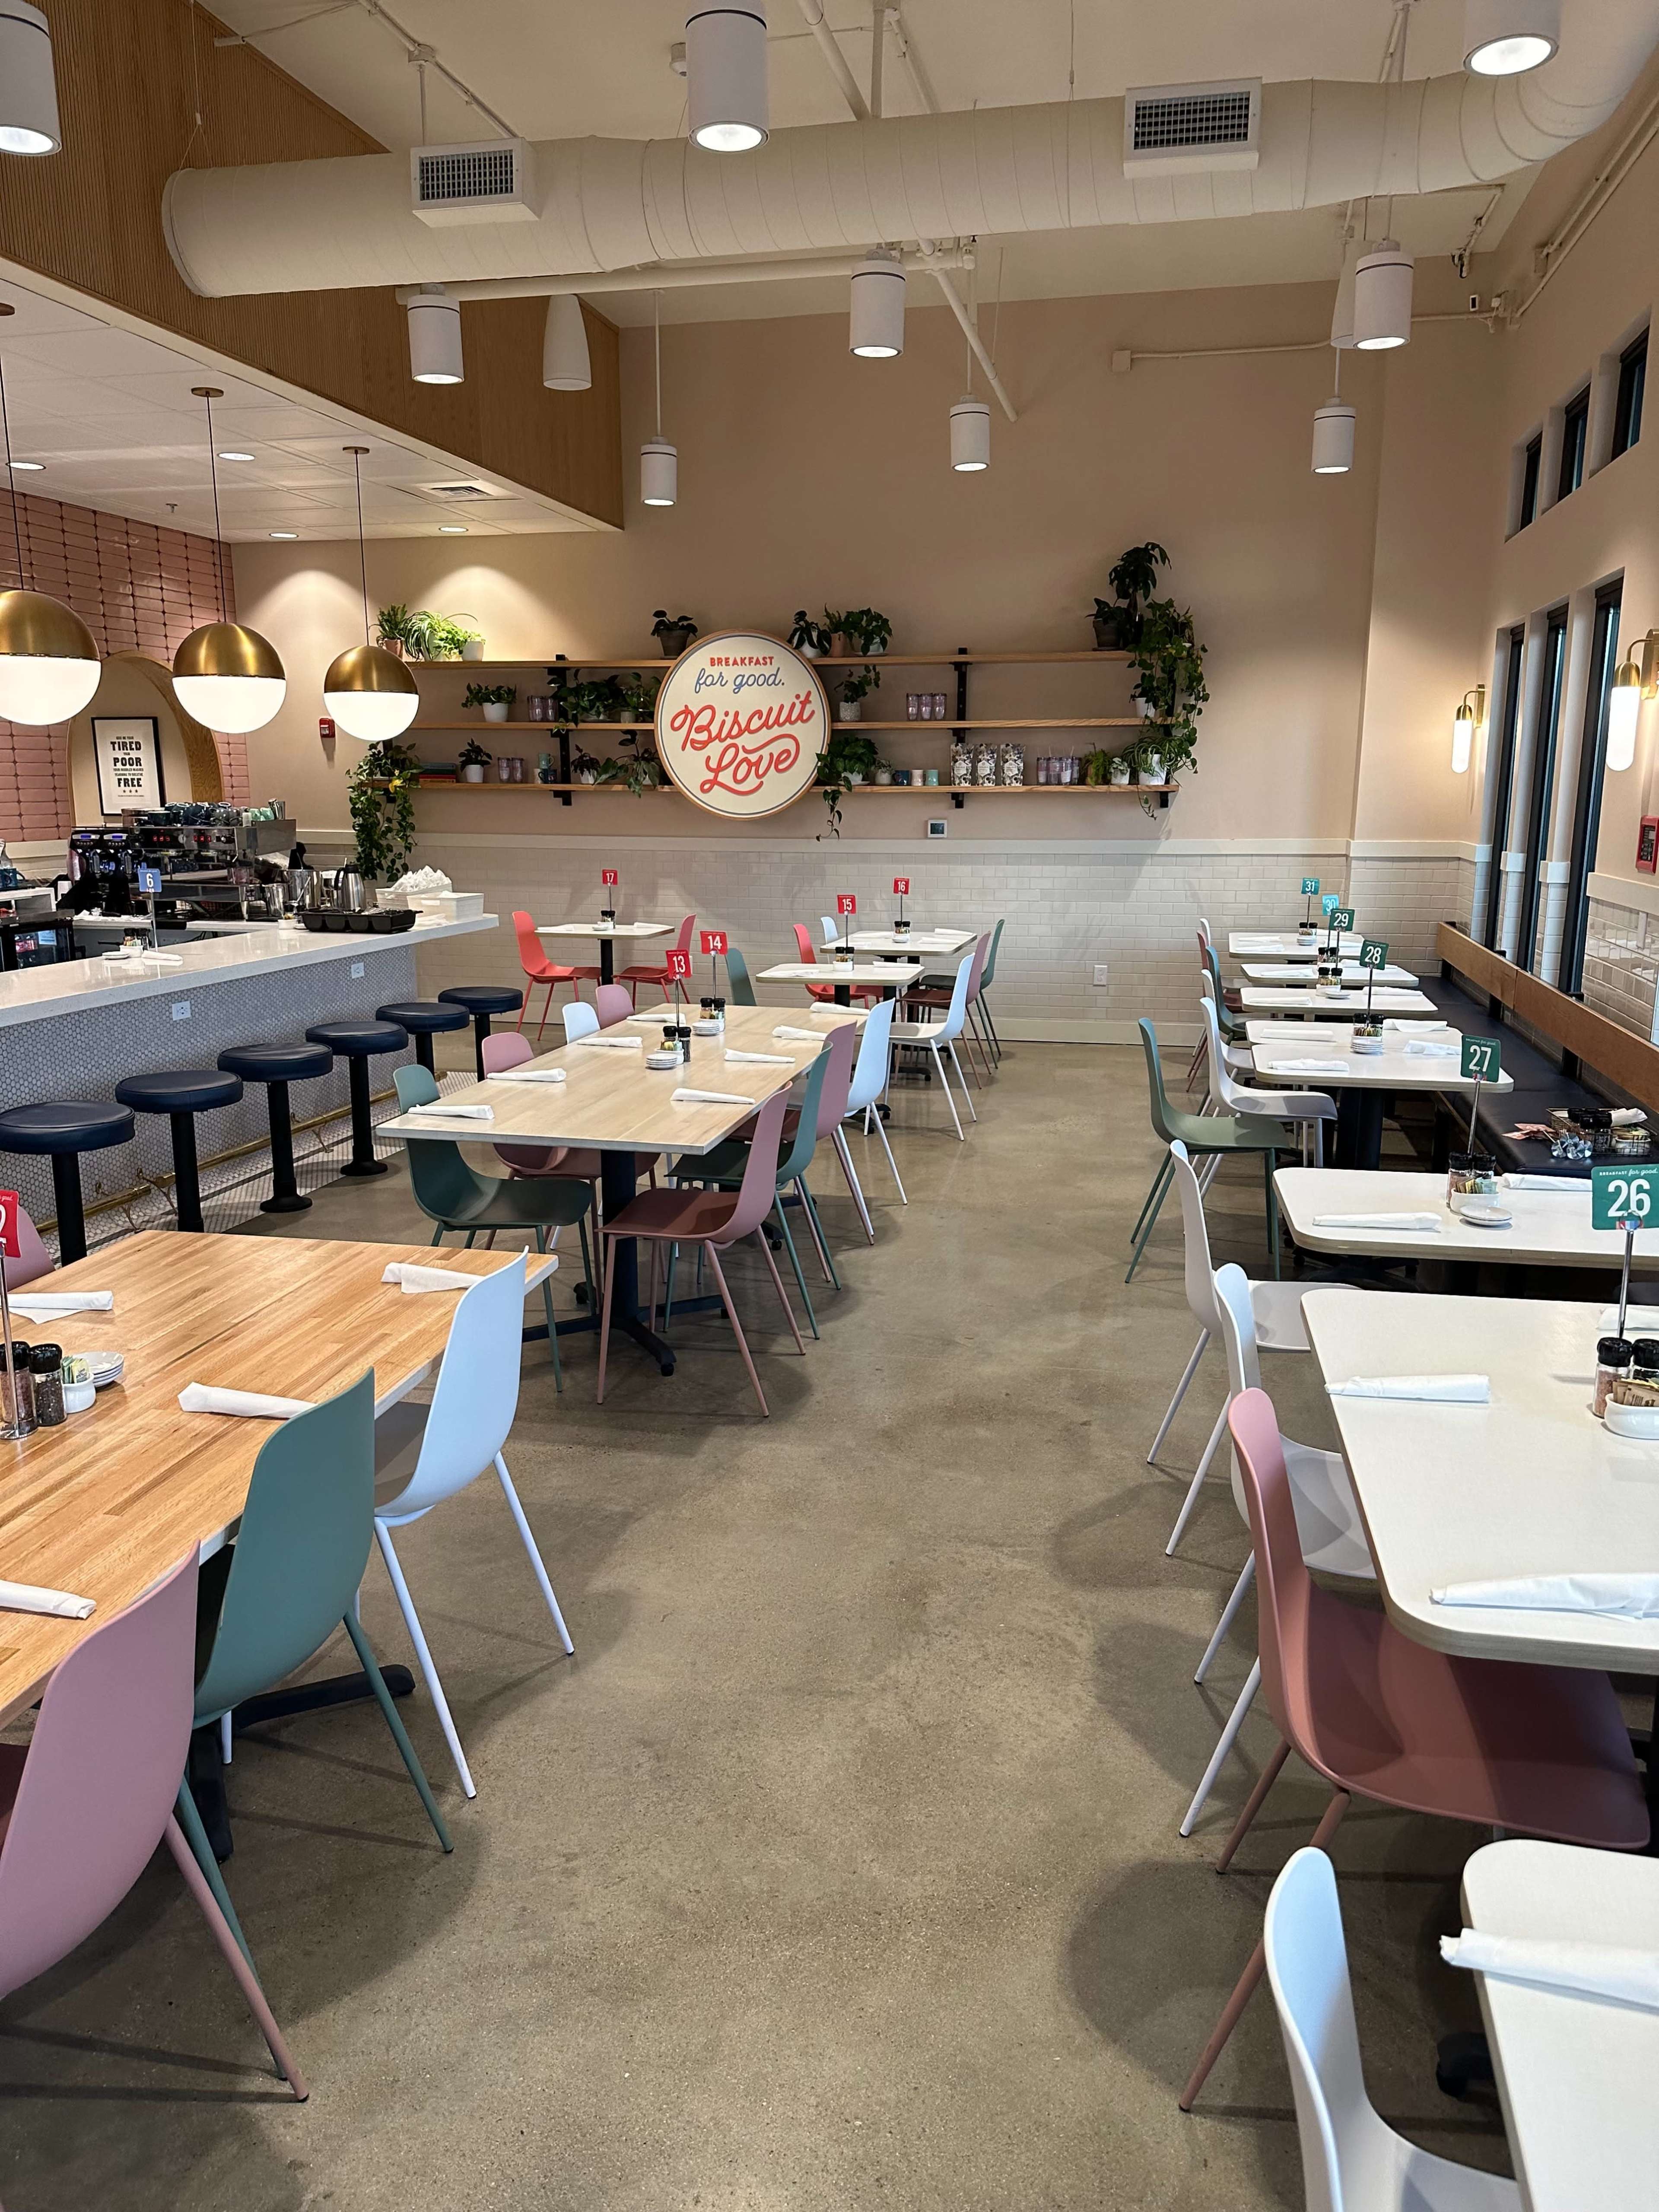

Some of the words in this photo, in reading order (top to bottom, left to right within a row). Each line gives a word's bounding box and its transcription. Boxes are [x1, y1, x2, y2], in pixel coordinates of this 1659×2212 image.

[710, 656, 774, 667] BREAKFAST
[695, 667, 728, 694] for
[733, 667, 785, 694] good.
[670, 690, 815, 752] Biscuit
[110, 741, 141, 751] TIRED
[113, 757, 142, 766] POOR
[700, 734, 800, 796] Love
[117, 778, 142, 787] FREE
[146, 873, 154, 887] 6
[606, 873, 614, 882] 17
[898, 881, 906, 891] 16
[1306, 881, 1315, 892] 31
[842, 899, 852, 910] 15
[1326, 899, 1336, 912] 30
[1334, 913, 1349, 927] 29
[708, 935, 722, 950] 14
[1365, 946, 1382, 964] 28
[673, 955, 686, 973] 13
[1469, 1045, 1491, 1072] 27
[1608, 1179, 1651, 1217] 26
